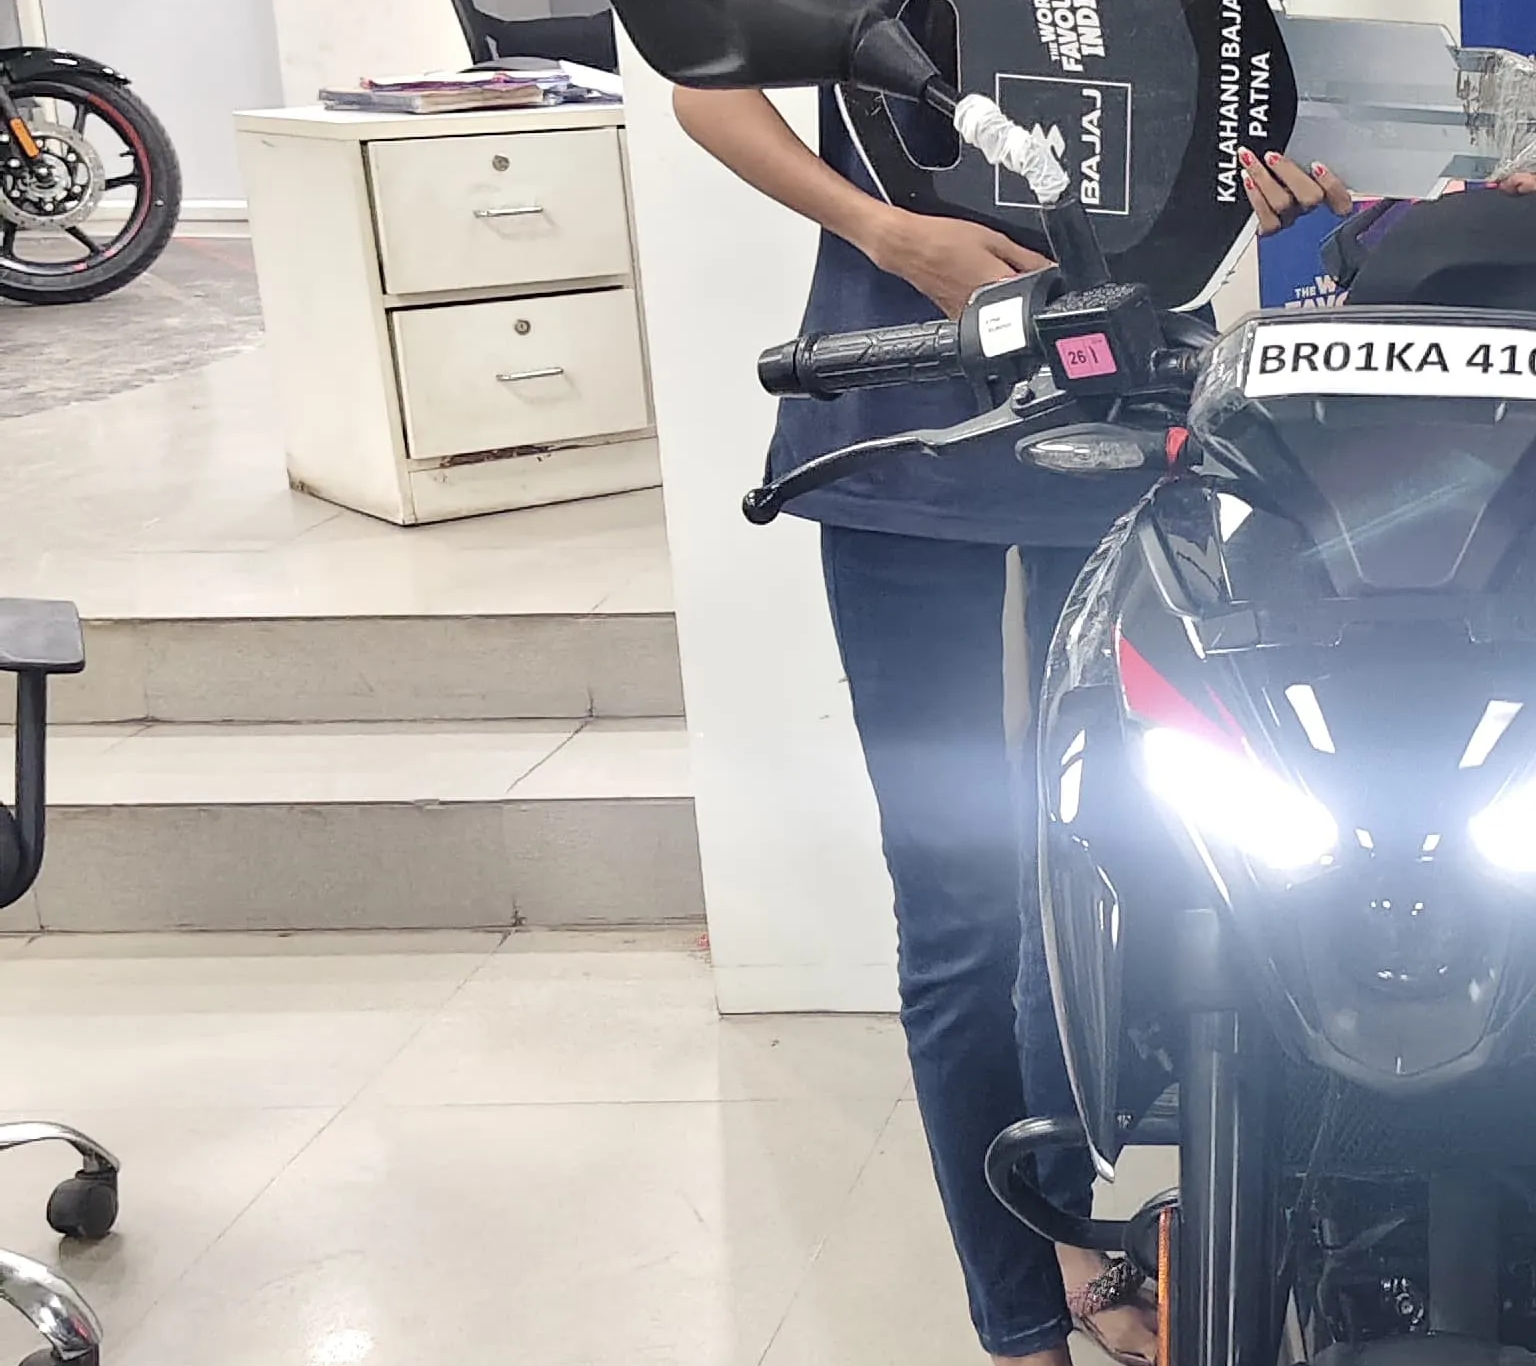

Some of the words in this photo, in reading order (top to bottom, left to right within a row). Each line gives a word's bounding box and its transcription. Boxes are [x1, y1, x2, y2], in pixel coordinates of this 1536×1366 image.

[1249, 51, 1271, 137] PATNA
[1080, 88, 1102, 205] BAJAJ
[1216, 63, 1239, 203] KALAHANU
[1294, 286, 1316, 299] THE
[1068, 350, 1087, 365] 26
[1258, 341, 1451, 375] BR01KA
